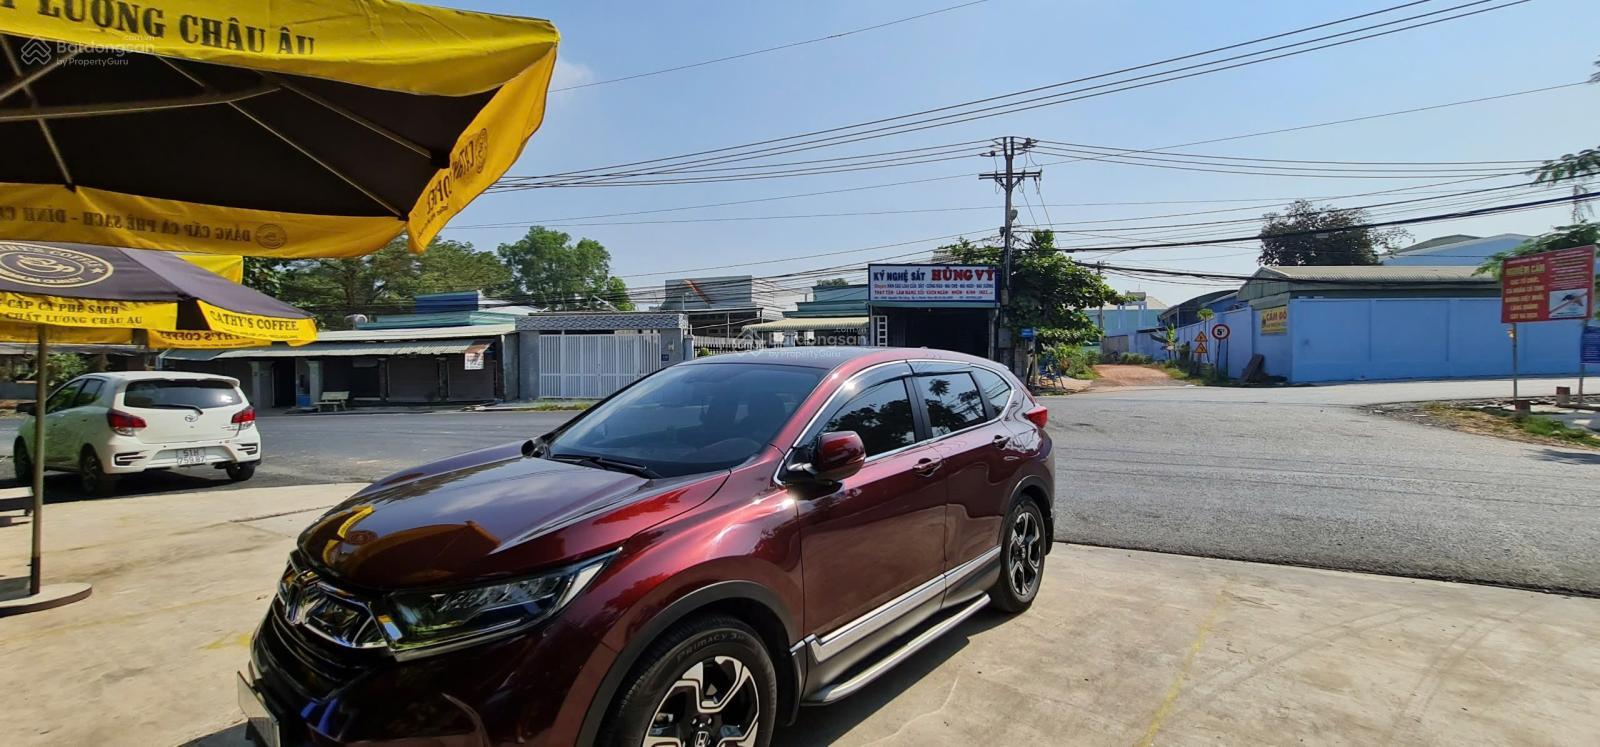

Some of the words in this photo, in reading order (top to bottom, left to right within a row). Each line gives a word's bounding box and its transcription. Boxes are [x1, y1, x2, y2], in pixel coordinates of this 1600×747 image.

[179, 14, 266, 53] CHÂU
[277, 26, 315, 55] ÂU
[257, 318, 300, 332] COFFEE
